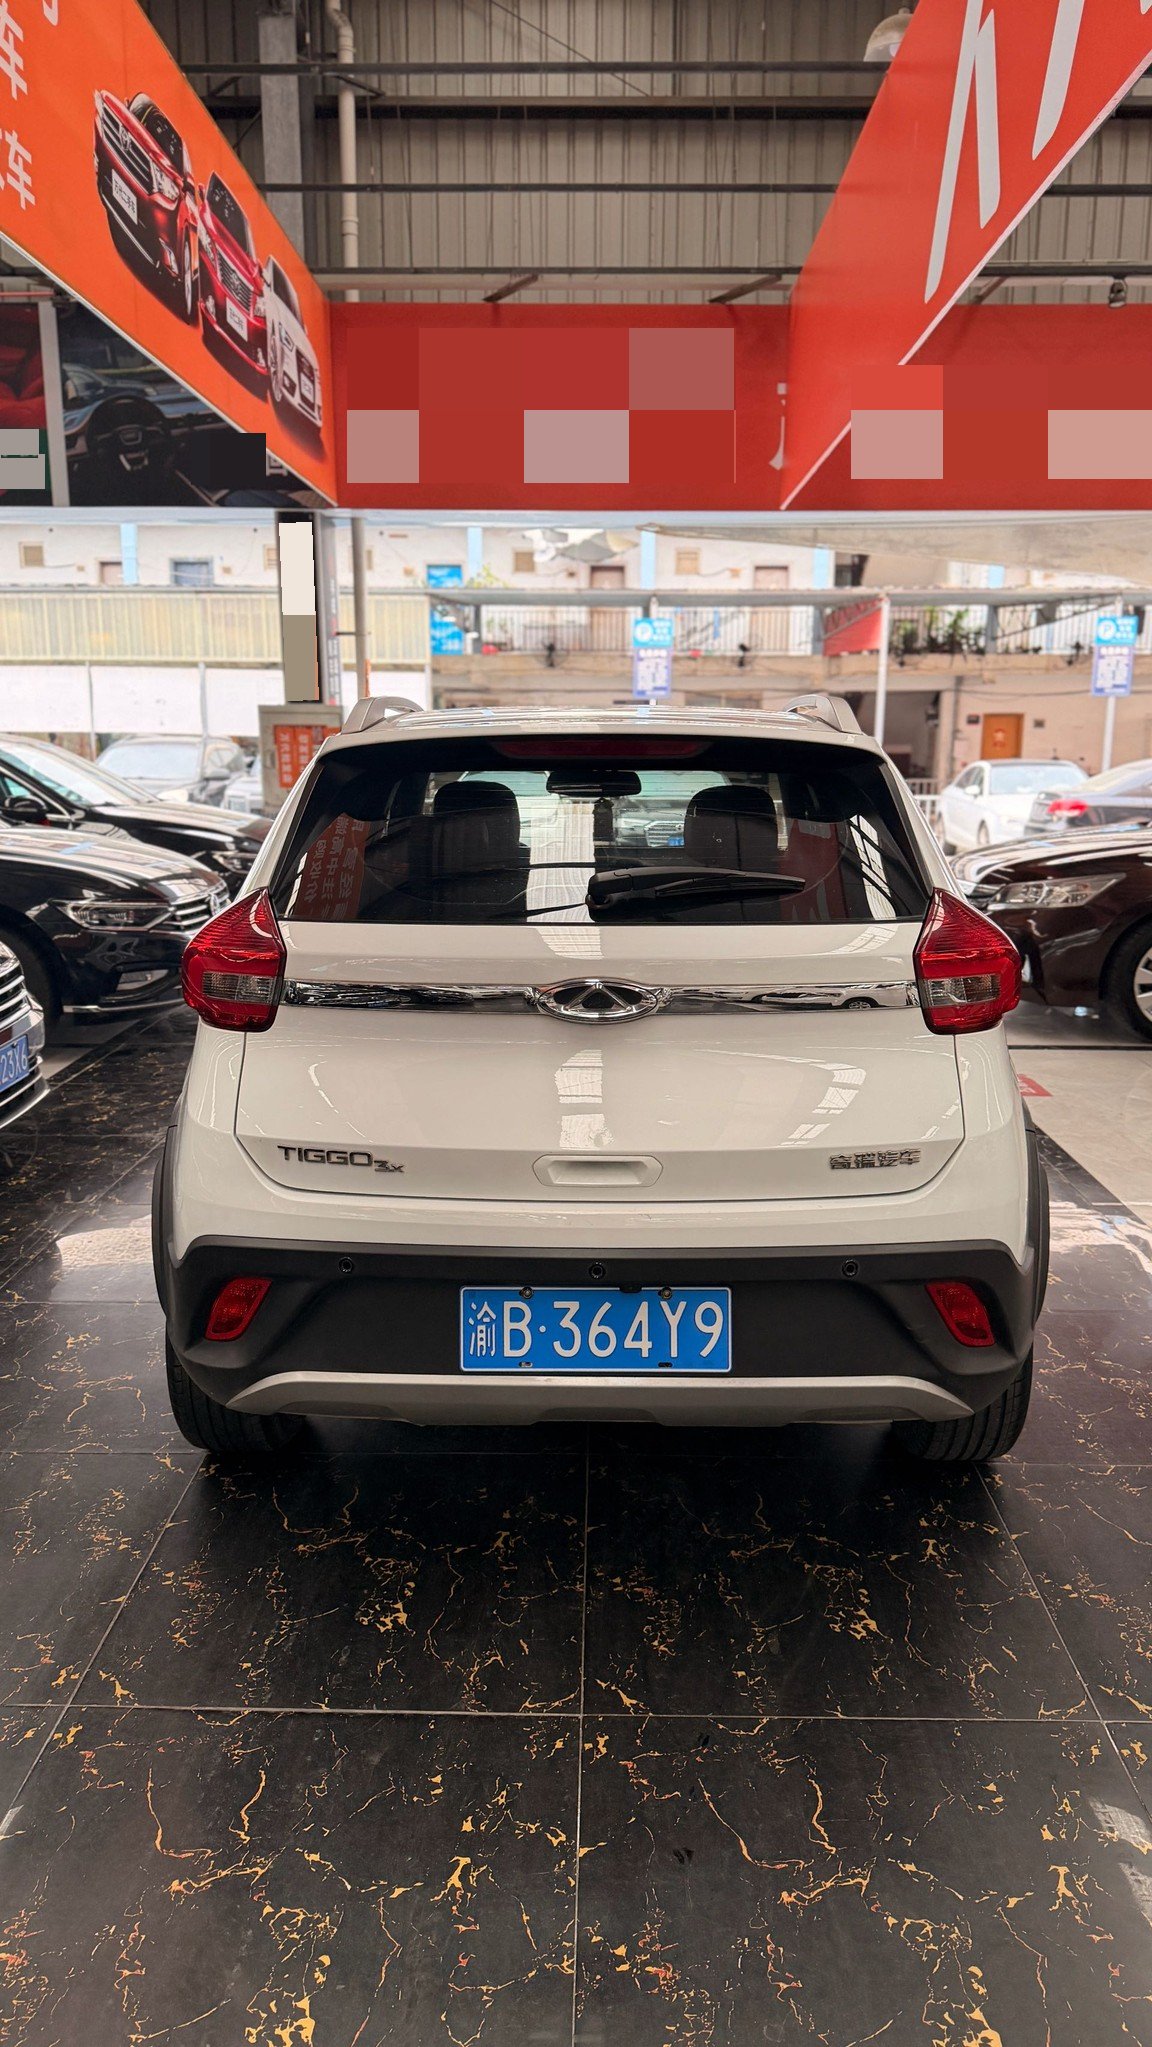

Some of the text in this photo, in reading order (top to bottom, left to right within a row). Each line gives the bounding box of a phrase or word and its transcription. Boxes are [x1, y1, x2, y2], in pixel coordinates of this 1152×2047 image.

[277, 1145, 373, 1167] TIGGO
[829, 1148, 921, 1170] 奇瑞汽车
